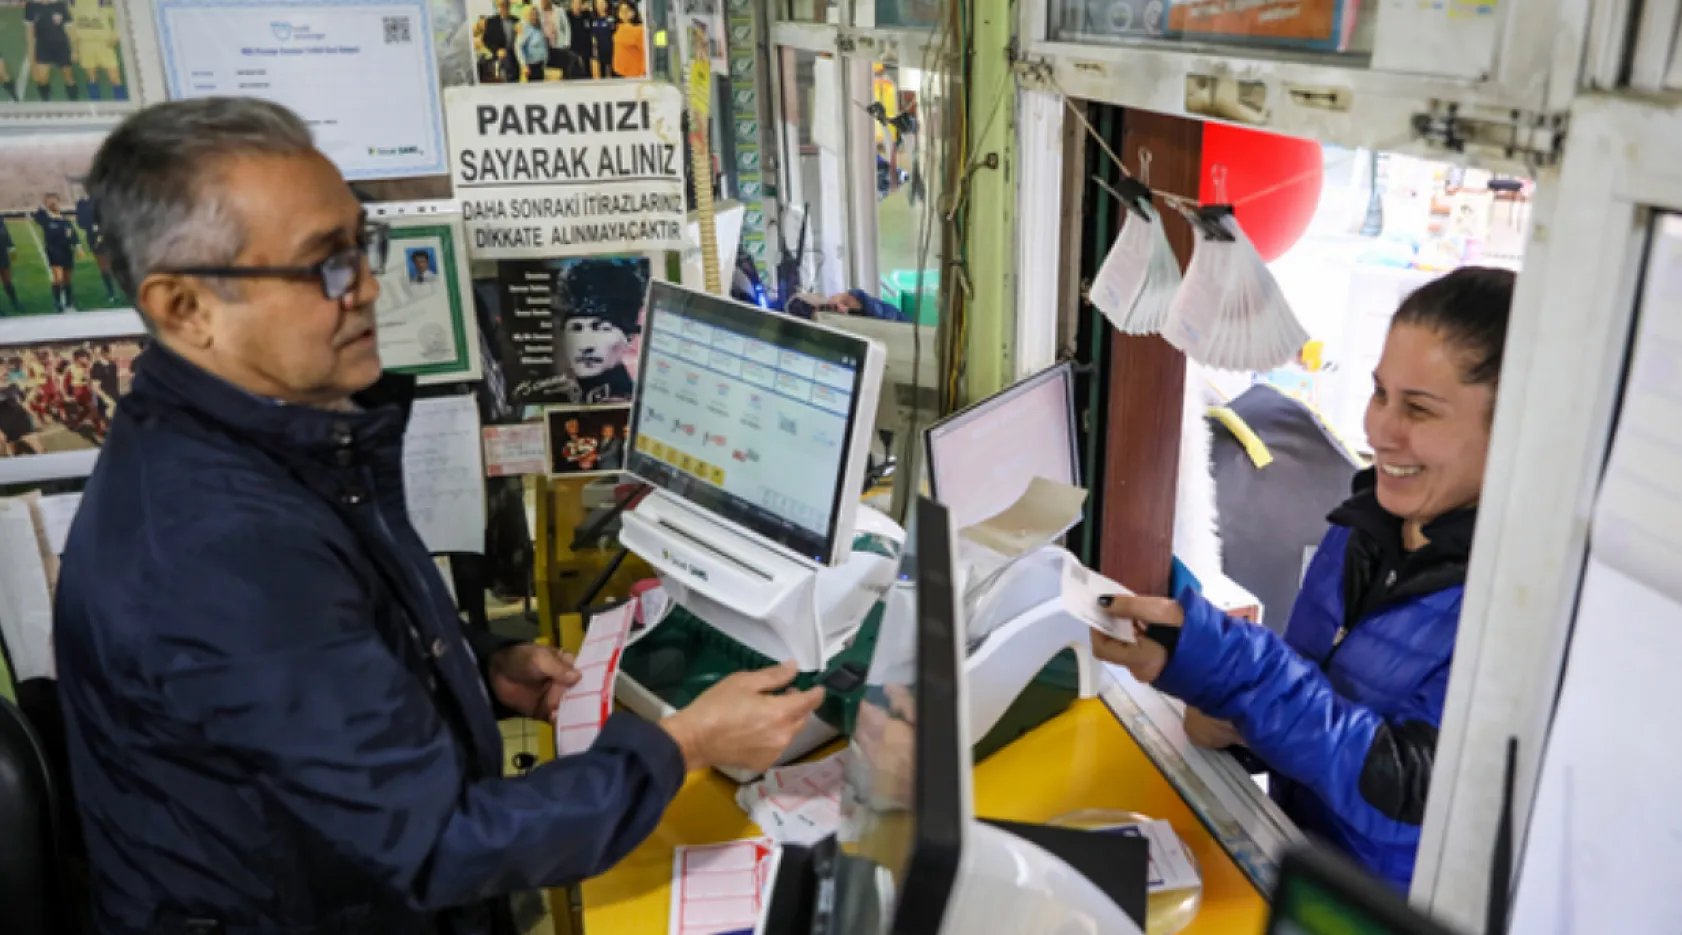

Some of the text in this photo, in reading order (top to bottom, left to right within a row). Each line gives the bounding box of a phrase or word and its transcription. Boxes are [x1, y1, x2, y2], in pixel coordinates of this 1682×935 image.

[476, 101, 650, 136] PARANIZI
[460, 143, 677, 181] SAYARAK ALINIZ
[462, 200, 508, 221] DAHA
[476, 220, 681, 249] DİKKATE ALINMAYACAKTIR
